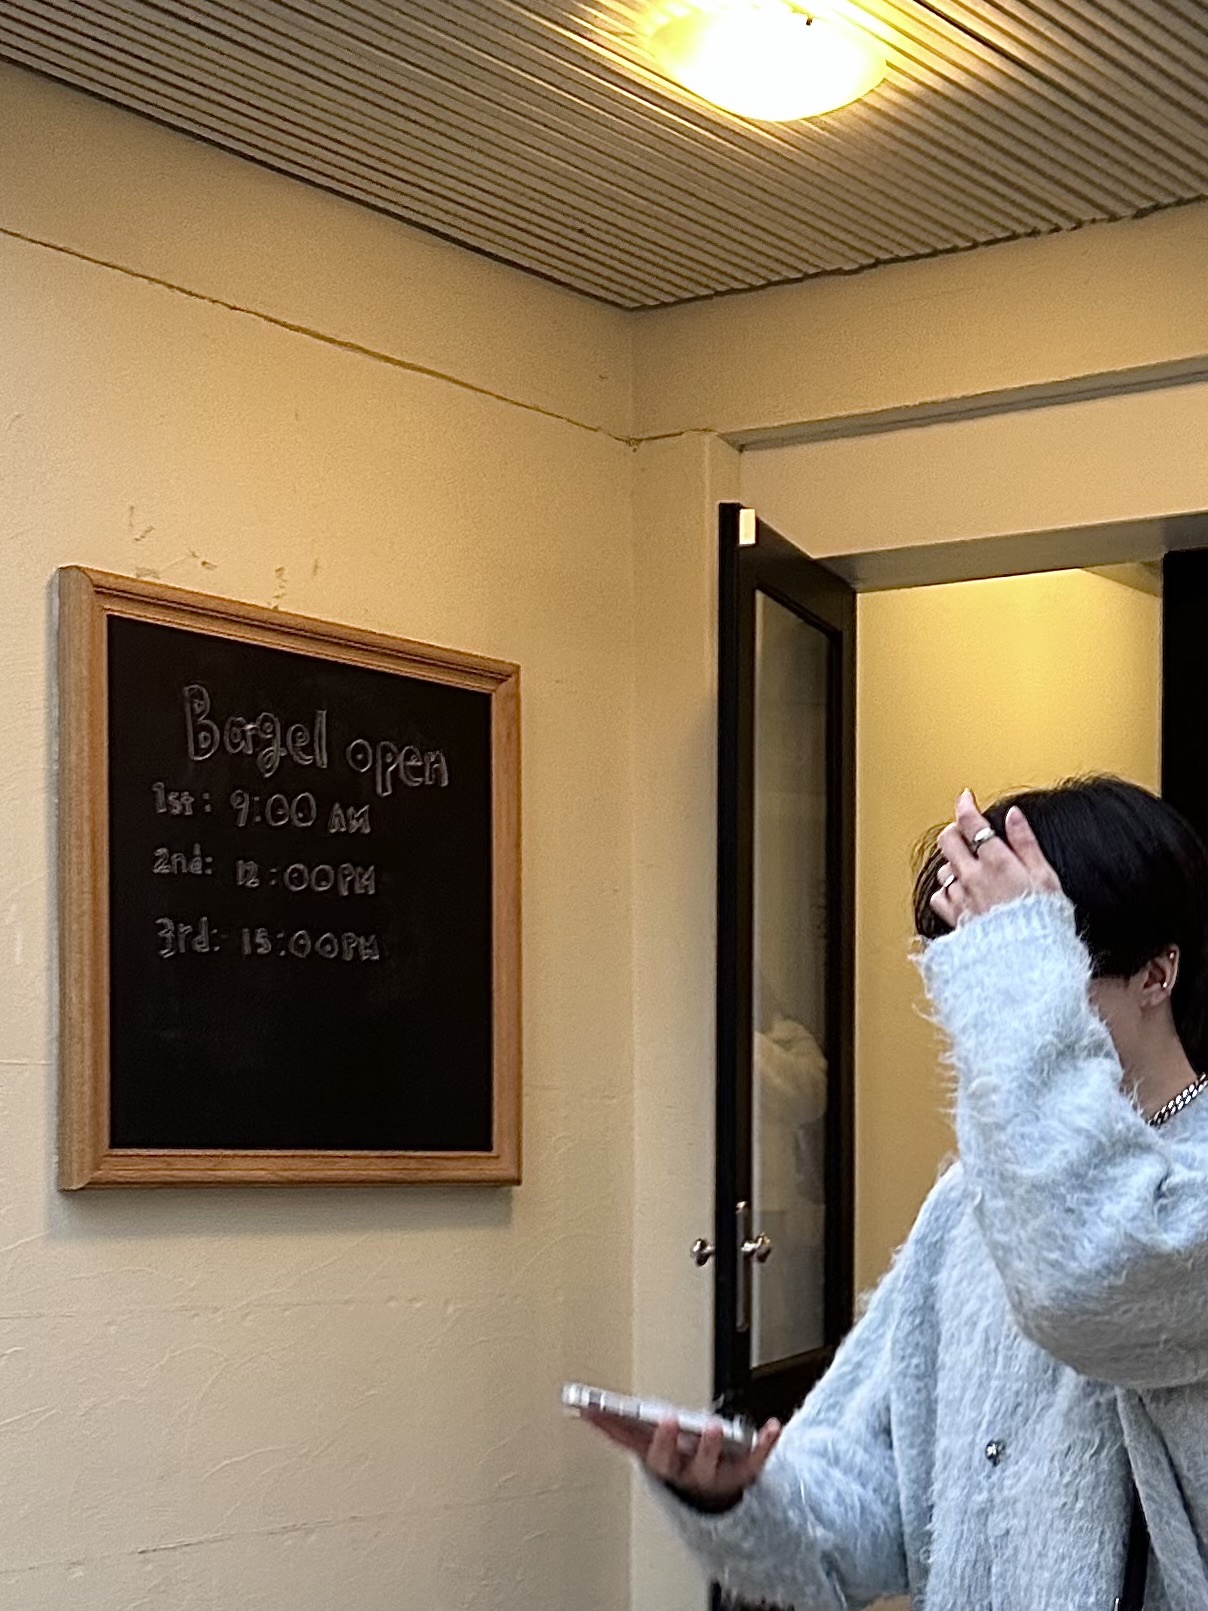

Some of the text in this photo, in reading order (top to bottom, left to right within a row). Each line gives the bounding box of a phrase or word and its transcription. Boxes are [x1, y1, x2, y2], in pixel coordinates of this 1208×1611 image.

[183, 683, 449, 797] Bagel open
[230, 789, 317, 828] 9:00
[328, 802, 372, 834] AM
[242, 927, 380, 962] 15:00PM
